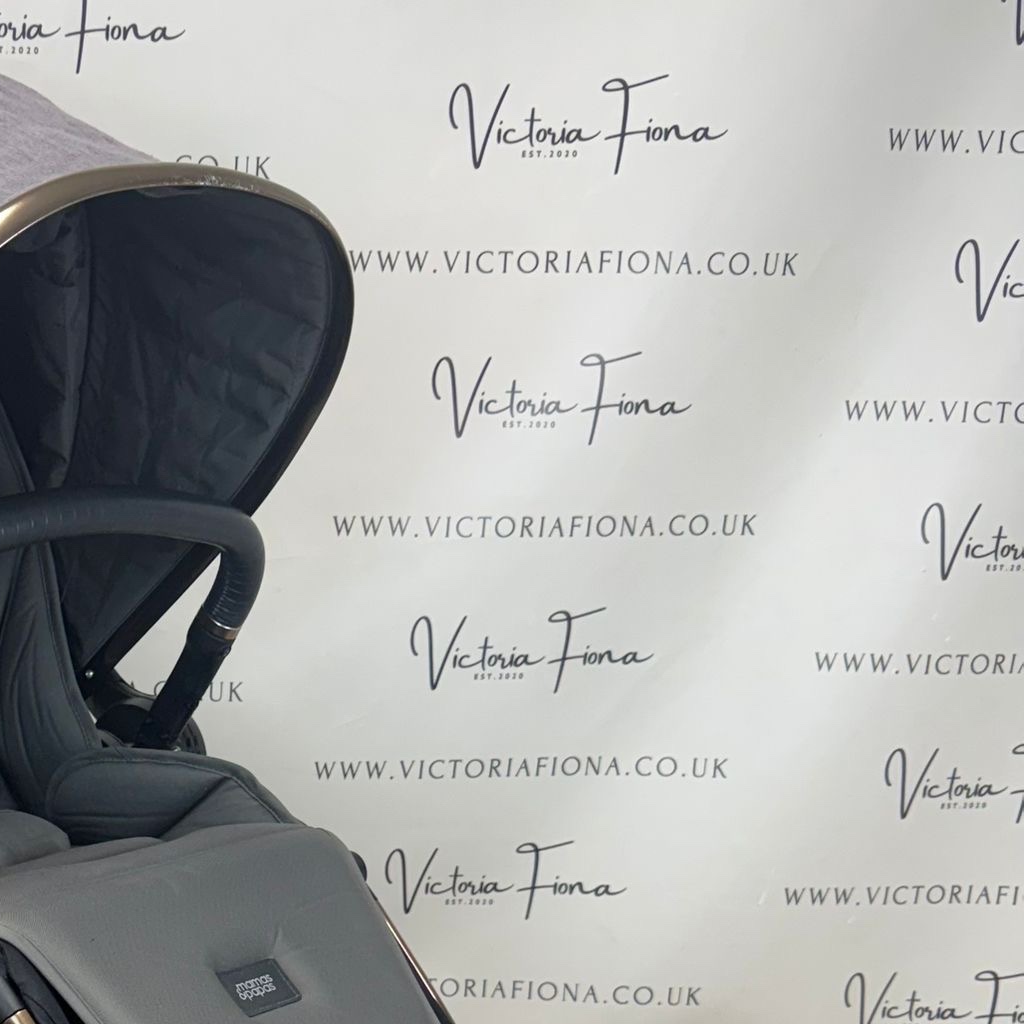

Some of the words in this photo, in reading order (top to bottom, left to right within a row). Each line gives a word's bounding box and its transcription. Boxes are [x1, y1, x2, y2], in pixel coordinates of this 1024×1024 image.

[449, 82, 601, 169] Victoria
[601, 73, 728, 175] Fiona
[521, 150, 578, 159] EST.2020
[349, 249, 798, 277] WWW.VICTORIAFIONA.CO.UK
[432, 356, 578, 438] Victoria
[580, 351, 692, 445] Fiona
[502, 420, 556, 429] EST.2020
[333, 513, 757, 538] WWW.VICTORIAFIONA.CO.UK
[410, 615, 546, 690] Victoria
[547, 607, 655, 694] Fiona
[473, 672, 525, 681] EST.2020
[314, 755, 729, 781] WWW.VICTORIAFIONA.CO.UK
[884, 747, 1009, 820] Victoria
[384, 847, 514, 914] Victoria
[516, 840, 627, 920] Fiona
